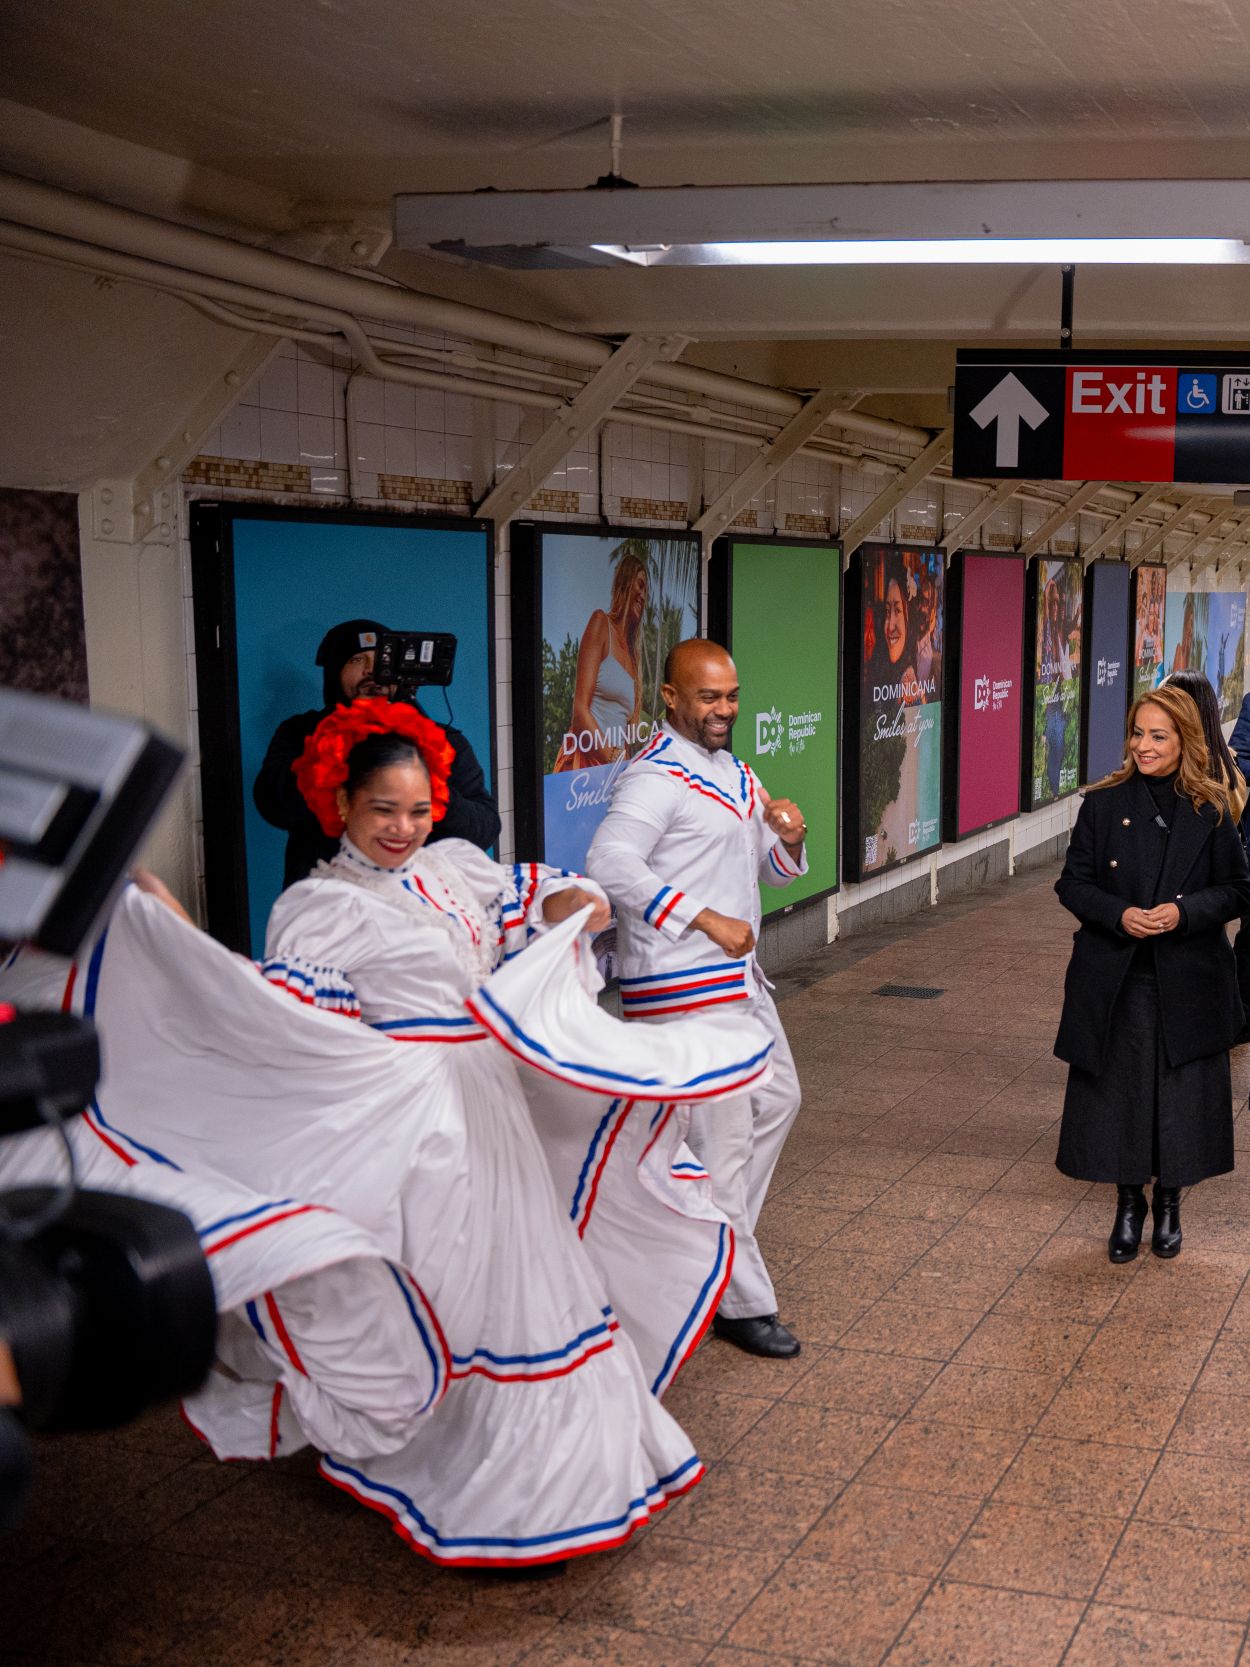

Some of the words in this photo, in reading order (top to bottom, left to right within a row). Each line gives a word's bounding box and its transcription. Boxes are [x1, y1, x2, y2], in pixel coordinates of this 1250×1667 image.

[1072, 372, 1166, 414] Exit
[873, 678, 936, 702] DOMINICANA
[788, 710, 822, 727] Dominican
[788, 723, 816, 741] Republic
[873, 700, 906, 741] Smiles
[907, 709, 922, 733] at
[914, 718, 935, 748] you
[563, 719, 664, 755] DOMINICA
[566, 750, 626, 811] Smil
